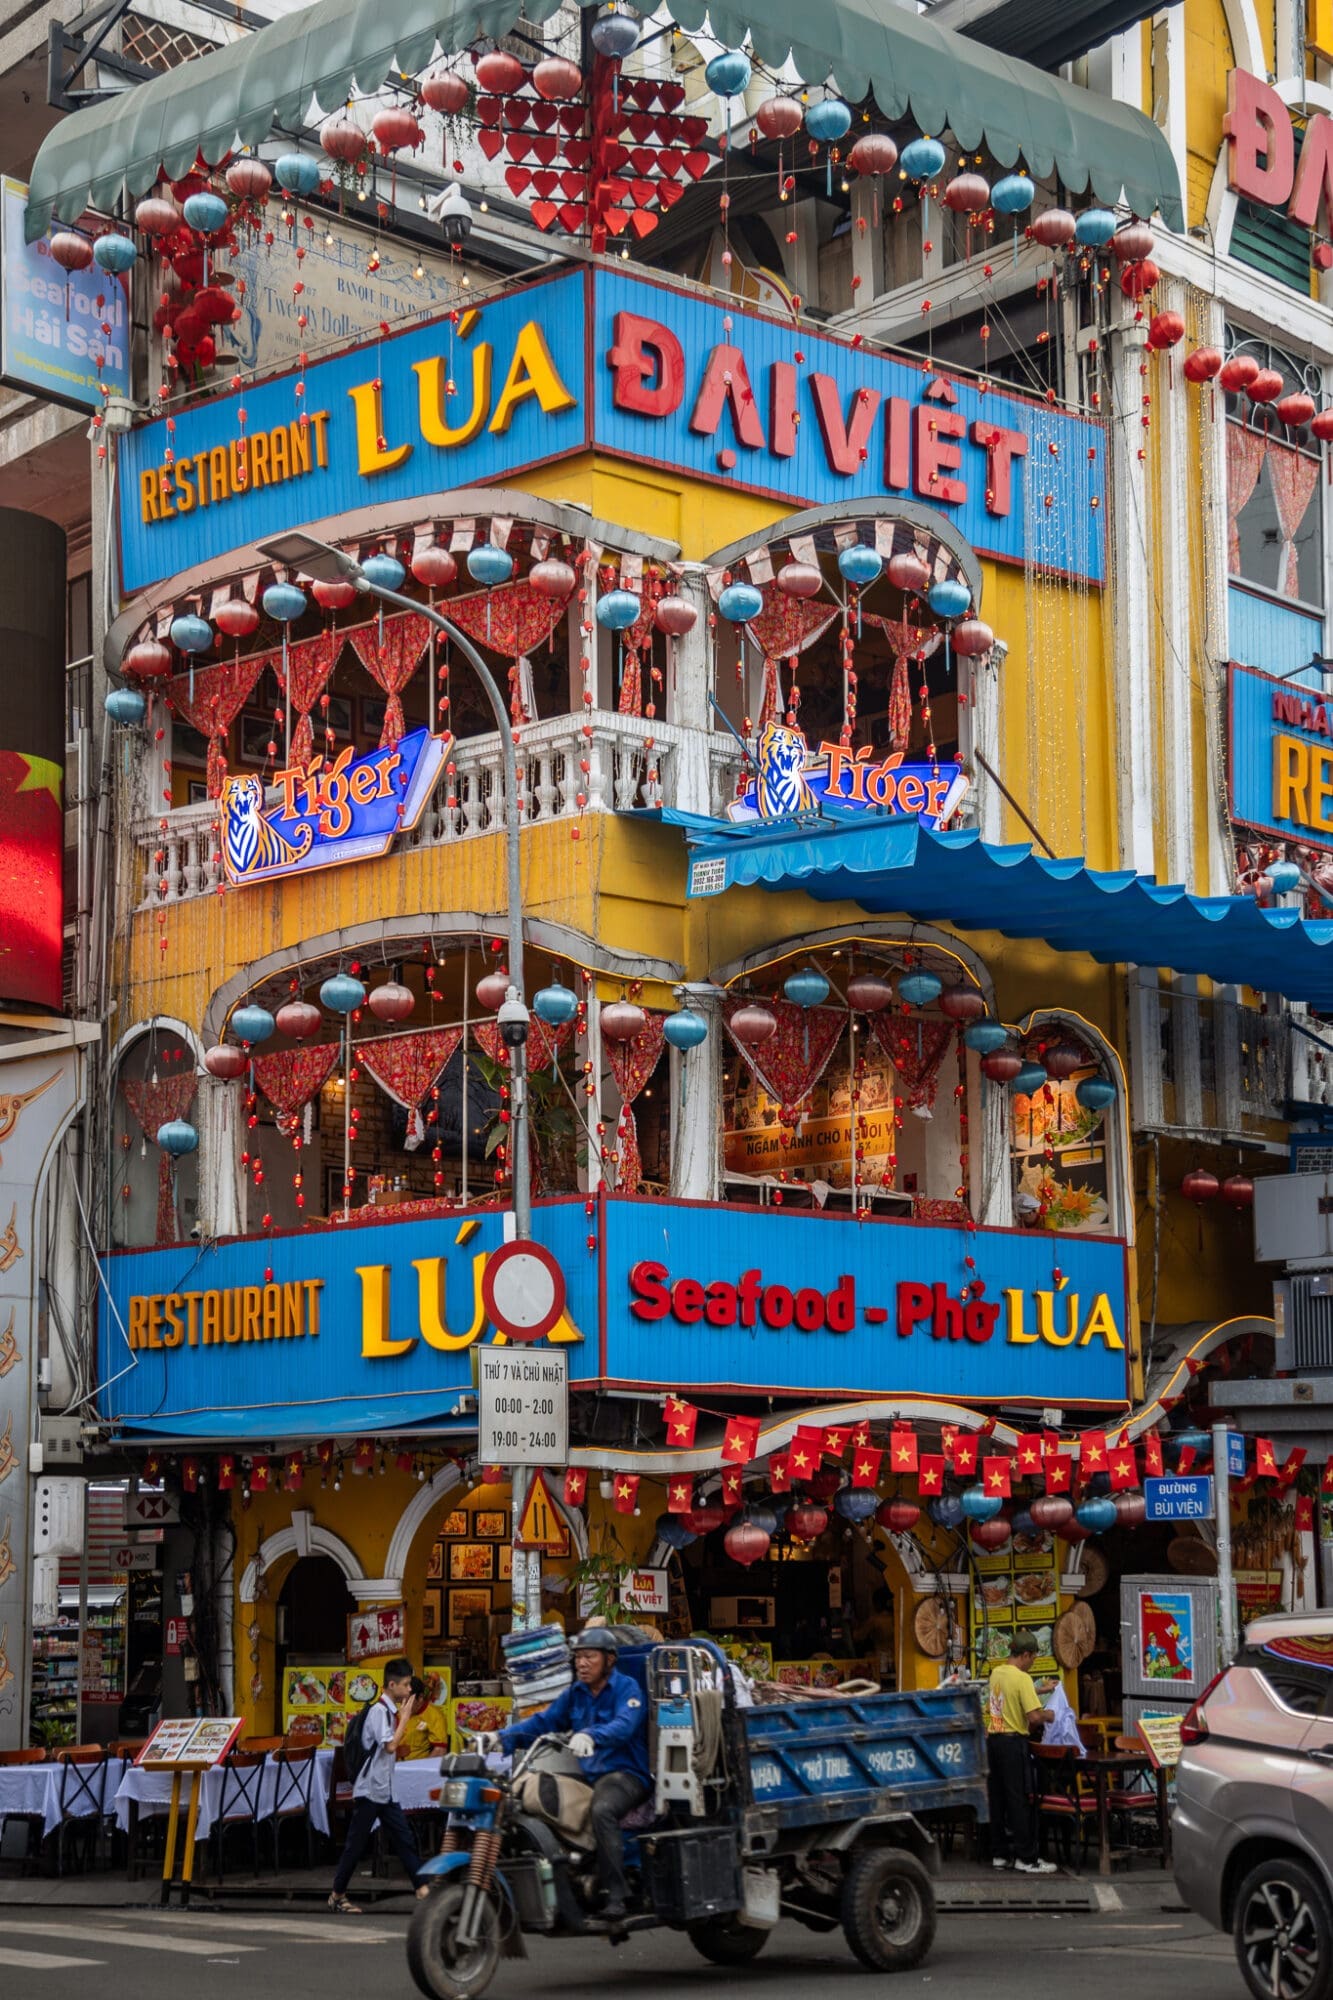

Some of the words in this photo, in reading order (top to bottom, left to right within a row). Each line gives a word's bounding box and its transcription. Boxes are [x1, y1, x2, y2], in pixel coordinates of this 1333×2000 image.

[11, 262, 123, 328] Seafood
[264, 286, 317, 333] Twenty
[12, 303, 61, 348] Hải
[66, 324, 123, 370] Sản
[139, 409, 329, 524] RESTAURANT
[347, 308, 577, 477] LÚA
[606, 311, 797, 471] ĐẠI
[808, 377, 1028, 519] VIỆT
[273, 746, 401, 838] Tiger
[819, 741, 949, 817] Tiger
[128, 1278, 326, 1349] RESTAURANT
[628, 1259, 856, 1333] Seafood
[896, 1279, 1000, 1343] Phở
[1003, 1277, 1125, 1350] LÚA
[484, 1360, 500, 1380] THỨ
[503, 1365, 508, 1380] 7
[511, 1361, 521, 1381] VÀ
[523, 1361, 540, 1381] CHỦ
[543, 1362, 563, 1386] NHẬT
[495, 1397, 522, 1413] 00:00
[533, 1399, 553, 1415] 2:00
[492, 1430, 518, 1447] 19:00
[529, 1431, 556, 1447] 24:00
[1155, 1499, 1174, 1515] BÙI
[1177, 1499, 1203, 1517] VIỆN
[1159, 1481, 1197, 1494] ĐƯỜNG
[634, 1576, 653, 1590] LÚA
[643, 1591, 663, 1607] VIỆT
